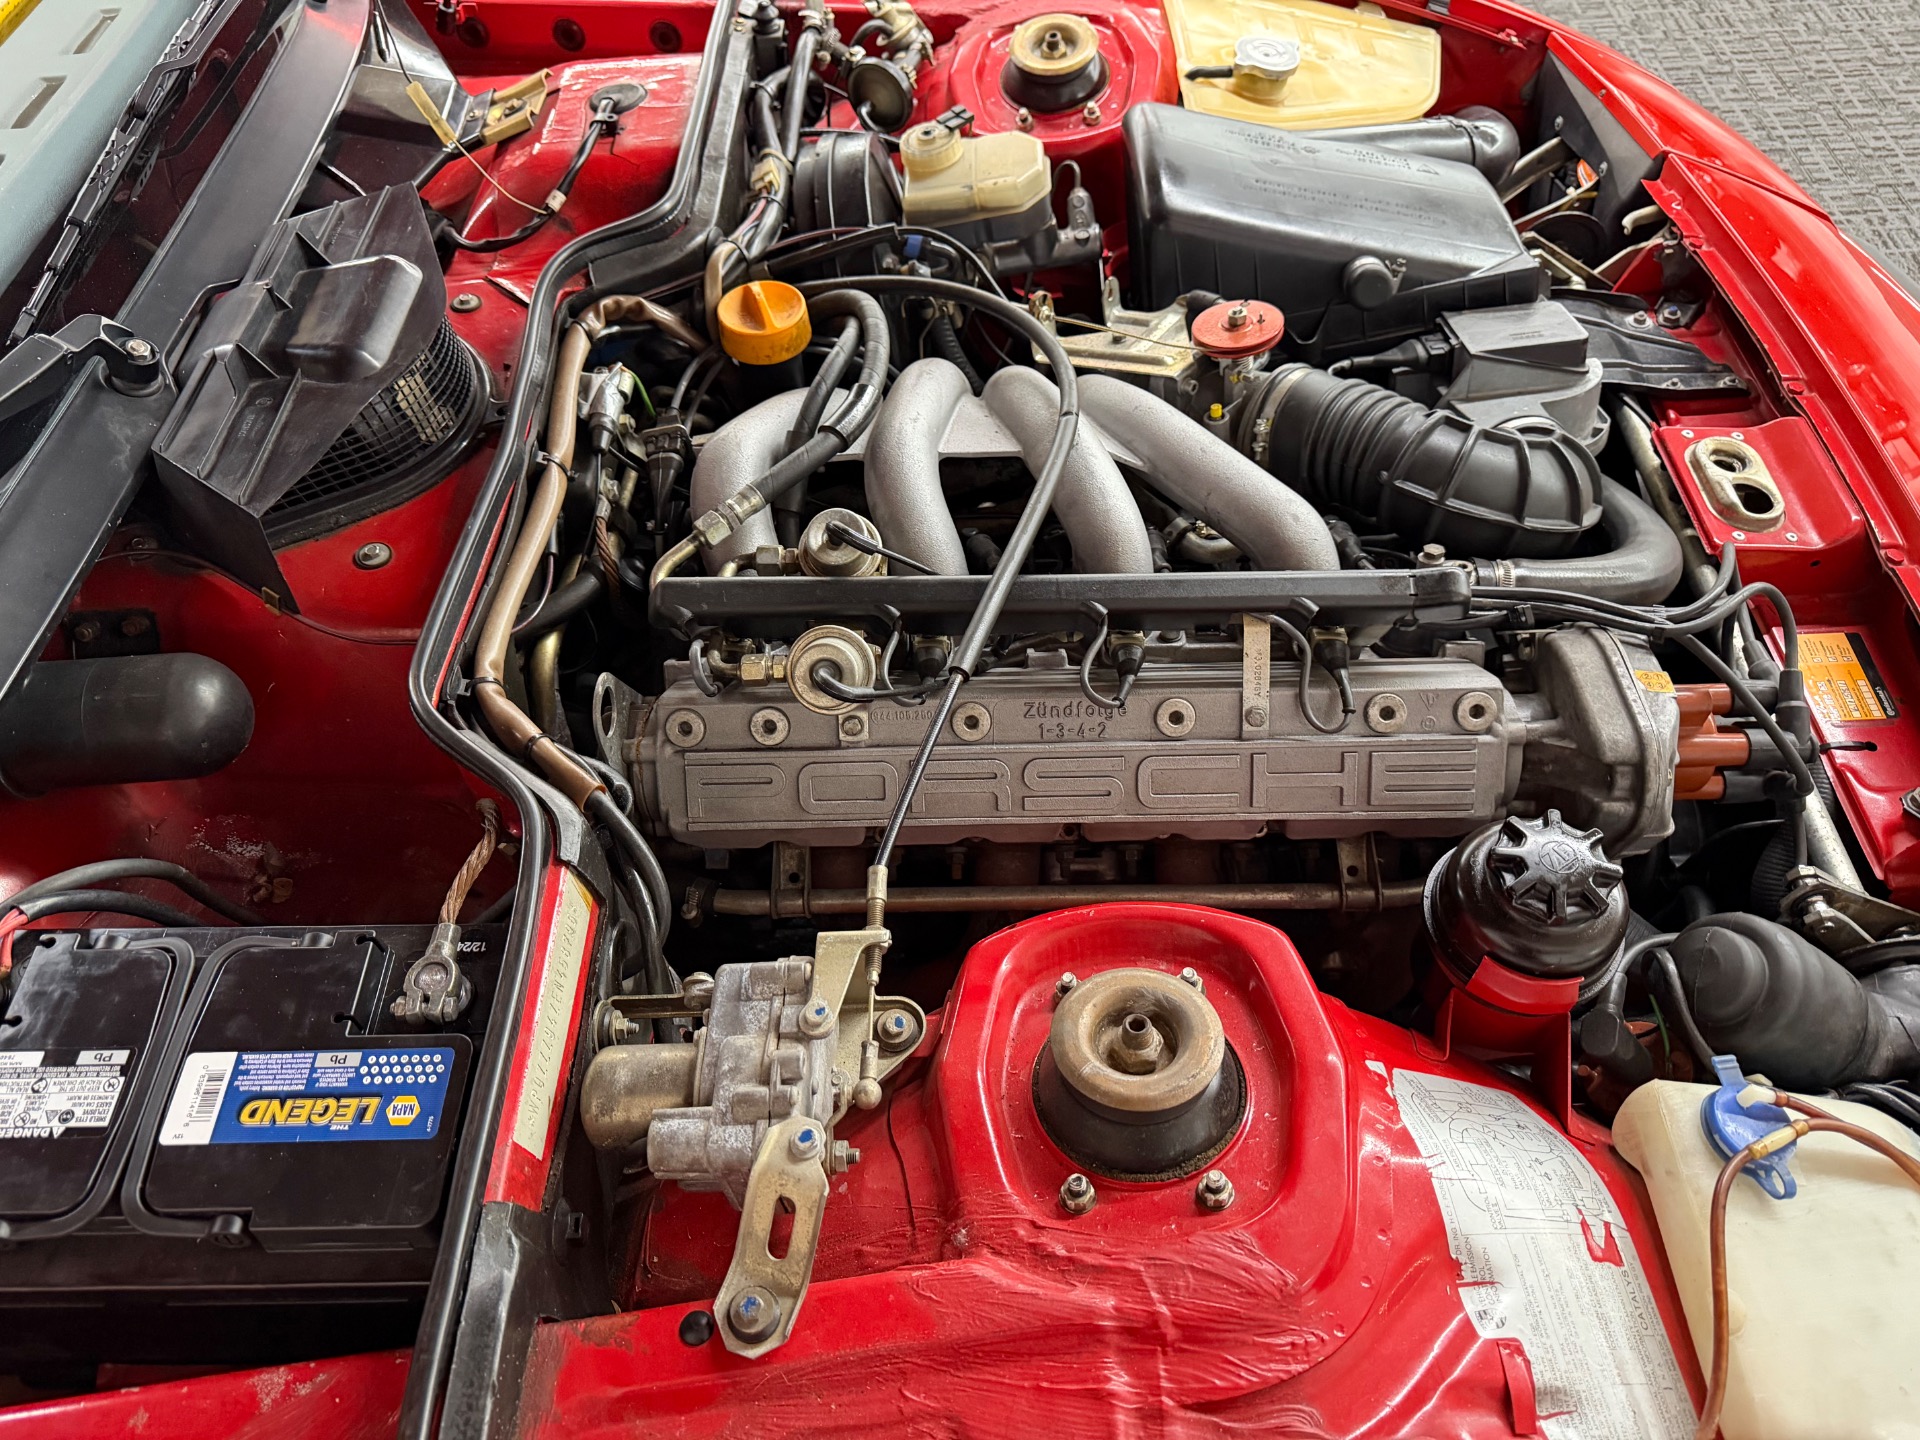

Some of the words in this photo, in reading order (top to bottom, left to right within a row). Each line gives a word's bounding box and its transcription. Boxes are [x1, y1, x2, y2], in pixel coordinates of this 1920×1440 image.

[1023, 700, 1129, 720] Zündfolge
[1039, 722, 1108, 739] 1-3-4-2
[686, 751, 1477, 817] PORSCHE
[457, 941, 487, 952] 12/24
[94, 1052, 114, 1062] Pb
[330, 1054, 348, 1065] Pb
[239, 1096, 383, 1127] LEGEND
[391, 1103, 415, 1116] NAPA
[0, 1127, 51, 1138] DANGER
[1461, 1235, 1477, 1273] EMISSION
[1618, 1264, 1649, 1332] CATALYS
